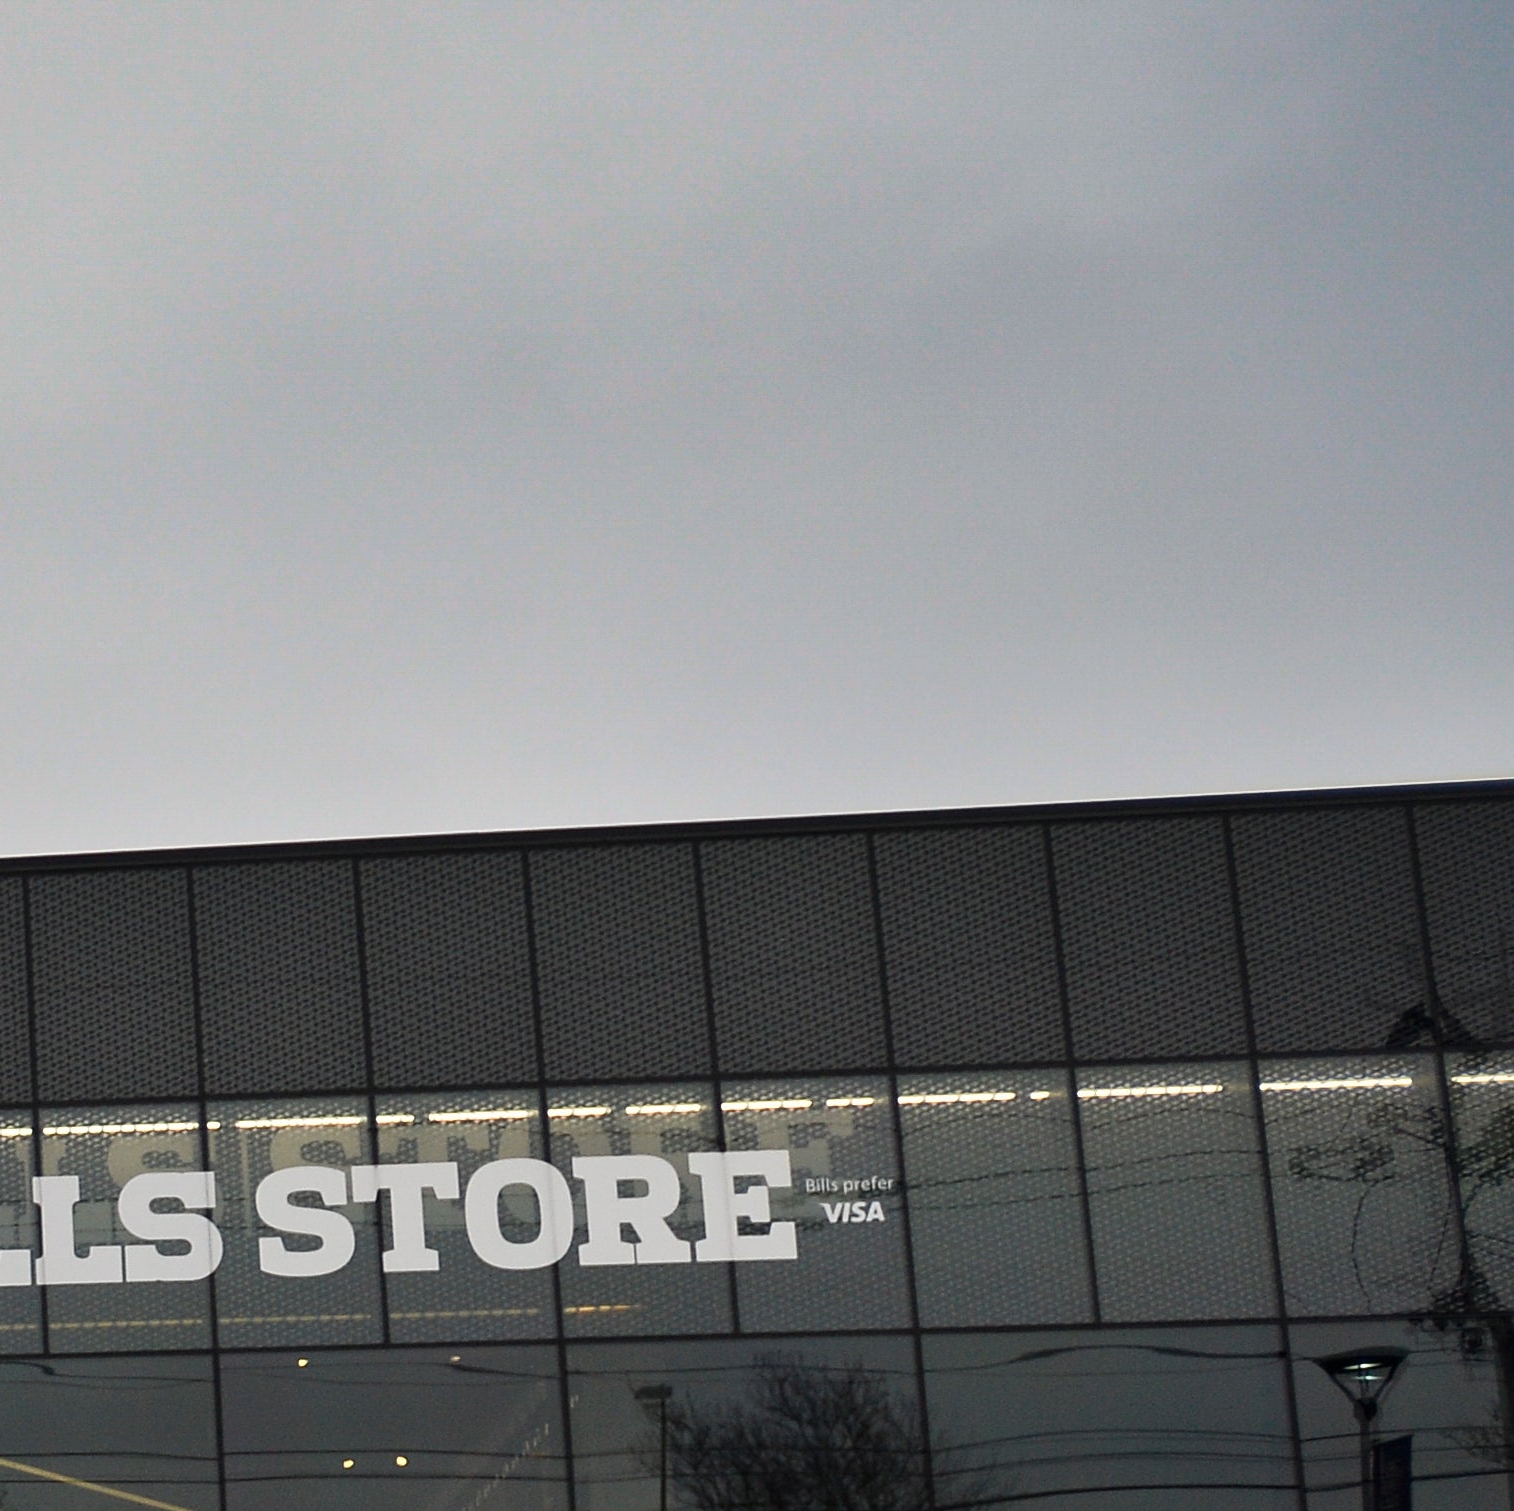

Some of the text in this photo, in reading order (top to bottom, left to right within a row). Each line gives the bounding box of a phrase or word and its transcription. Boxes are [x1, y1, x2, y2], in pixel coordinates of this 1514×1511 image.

[805, 1175, 895, 1195] Bills prefer
[254, 1149, 799, 1278] STORE
[819, 1201, 887, 1224] VISA
